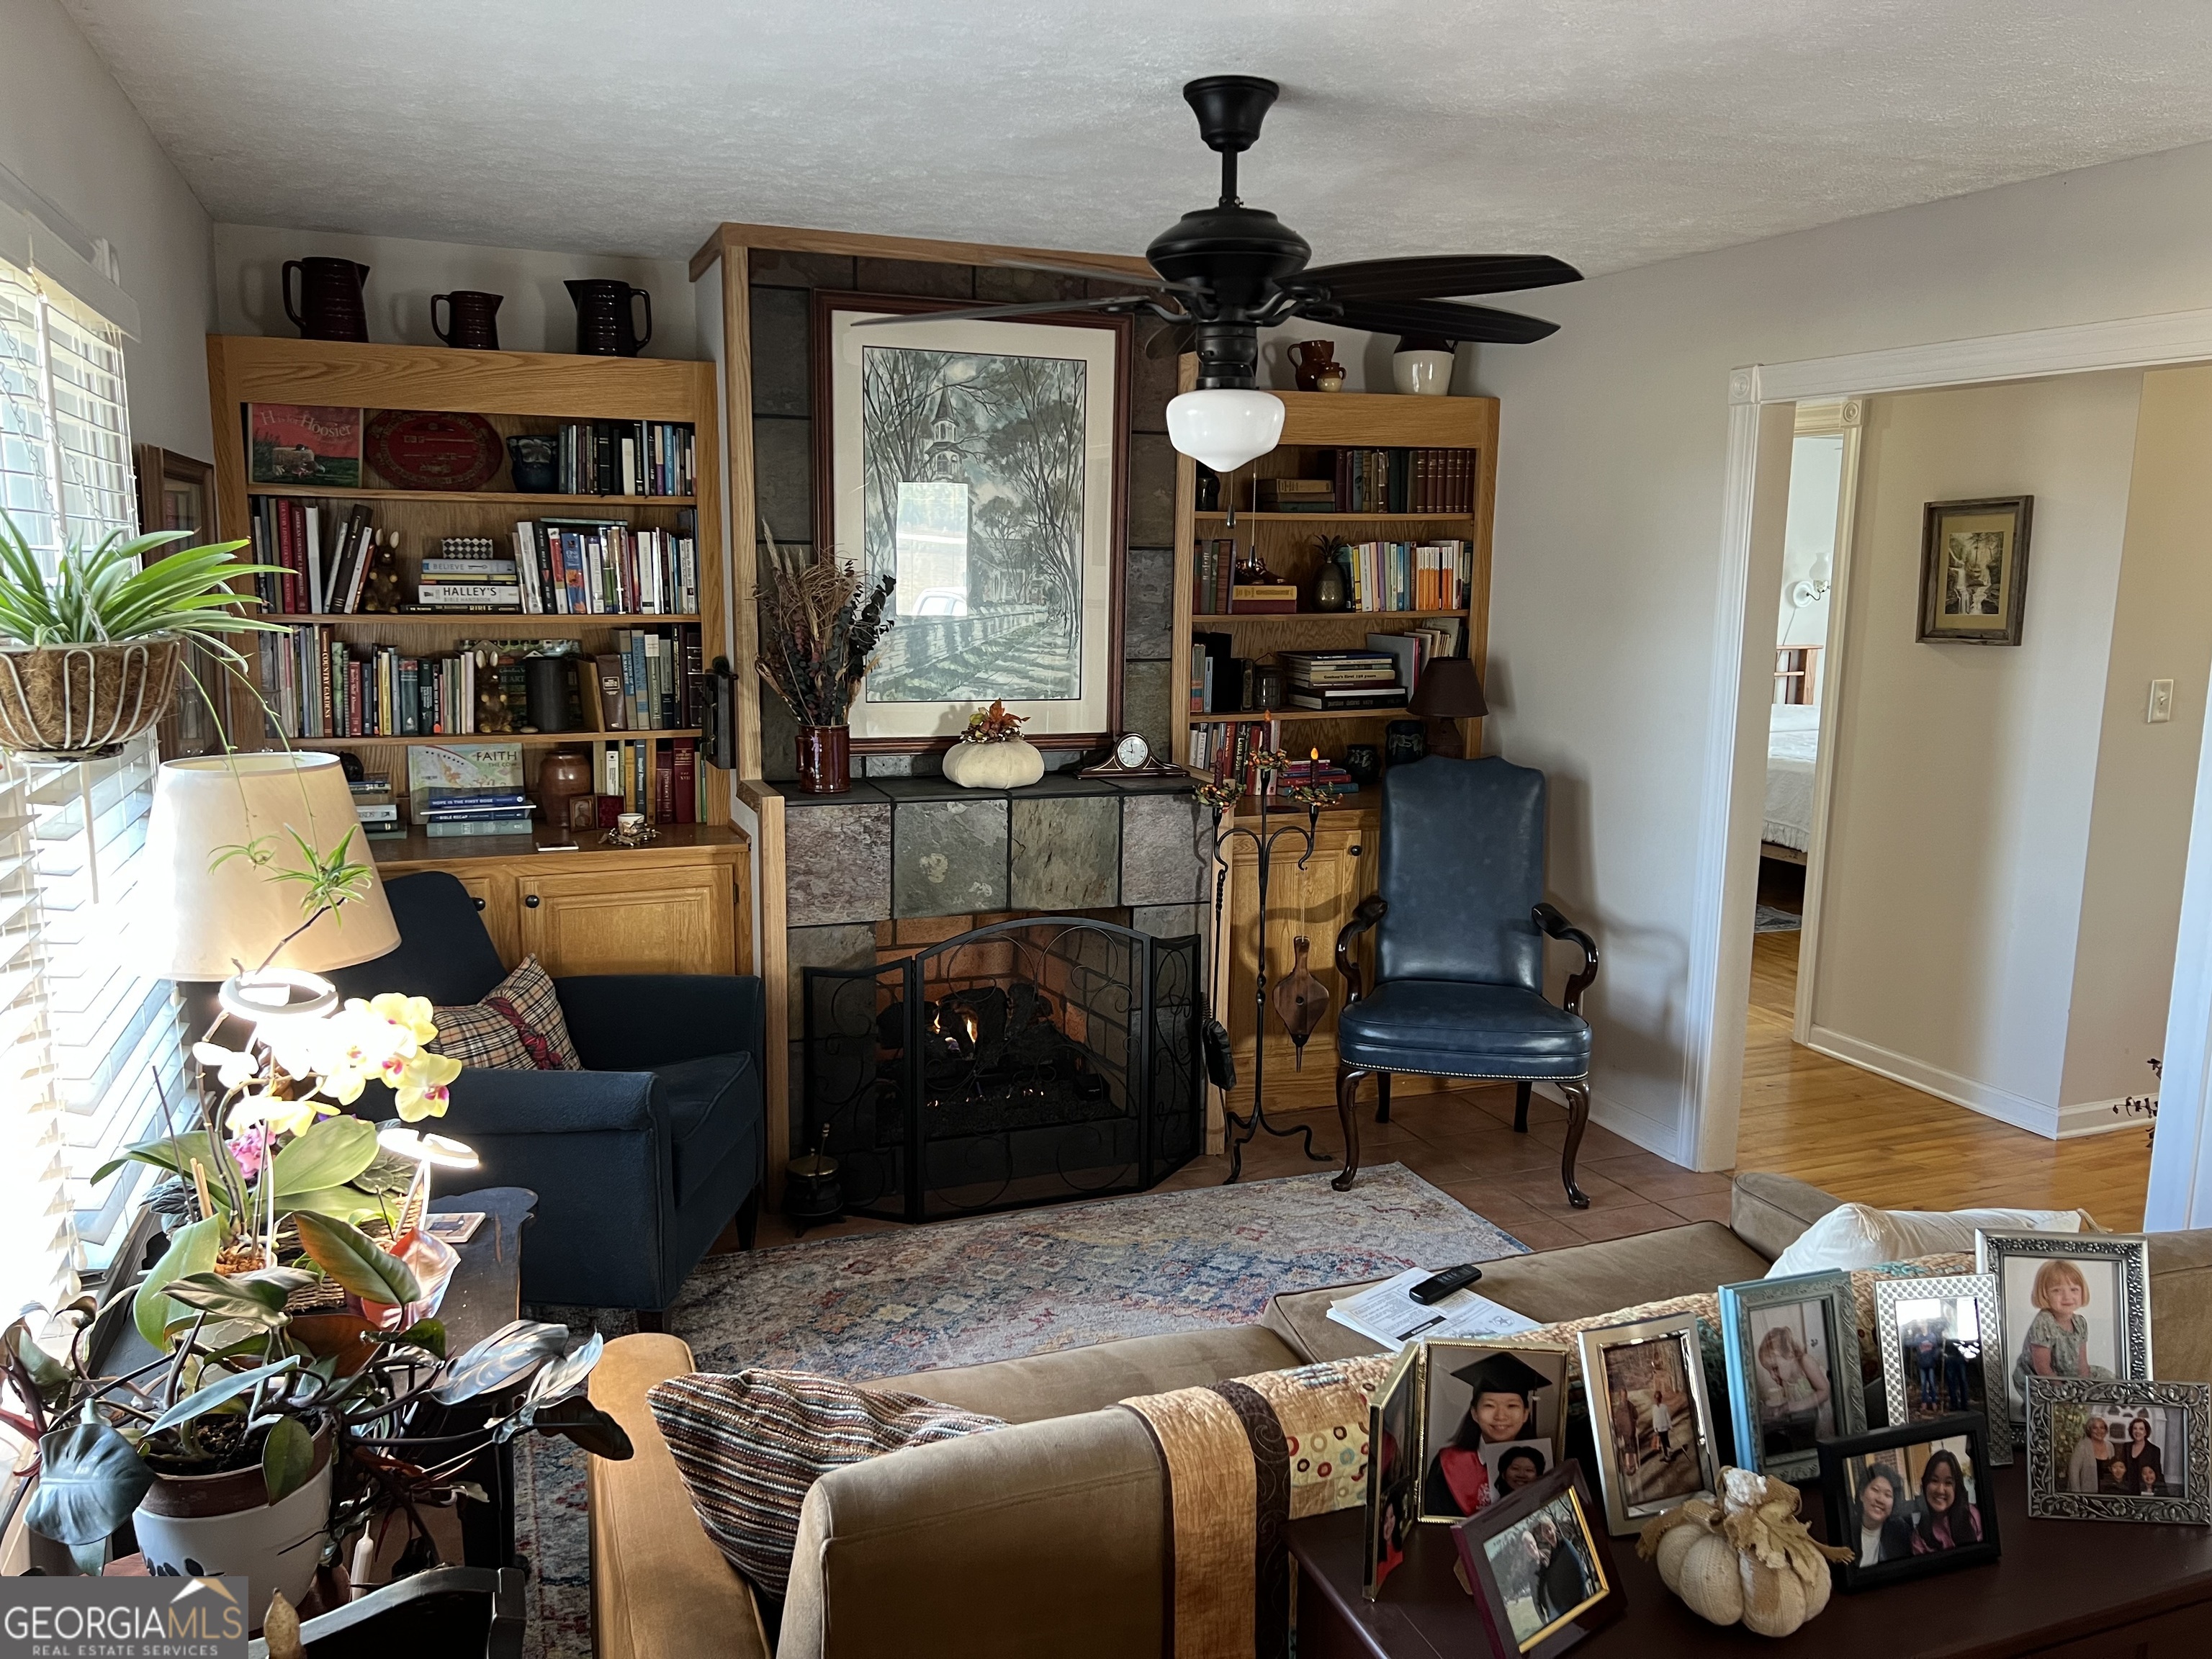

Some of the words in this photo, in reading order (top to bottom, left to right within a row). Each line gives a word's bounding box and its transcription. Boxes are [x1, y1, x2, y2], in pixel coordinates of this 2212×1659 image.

[260, 410, 276, 426] H
[300, 415, 351, 438] Hoosier
[444, 587, 497, 597] HALLEY'S
[1236, 737, 1245, 756] LAURA
[476, 750, 518, 762] FAITH
